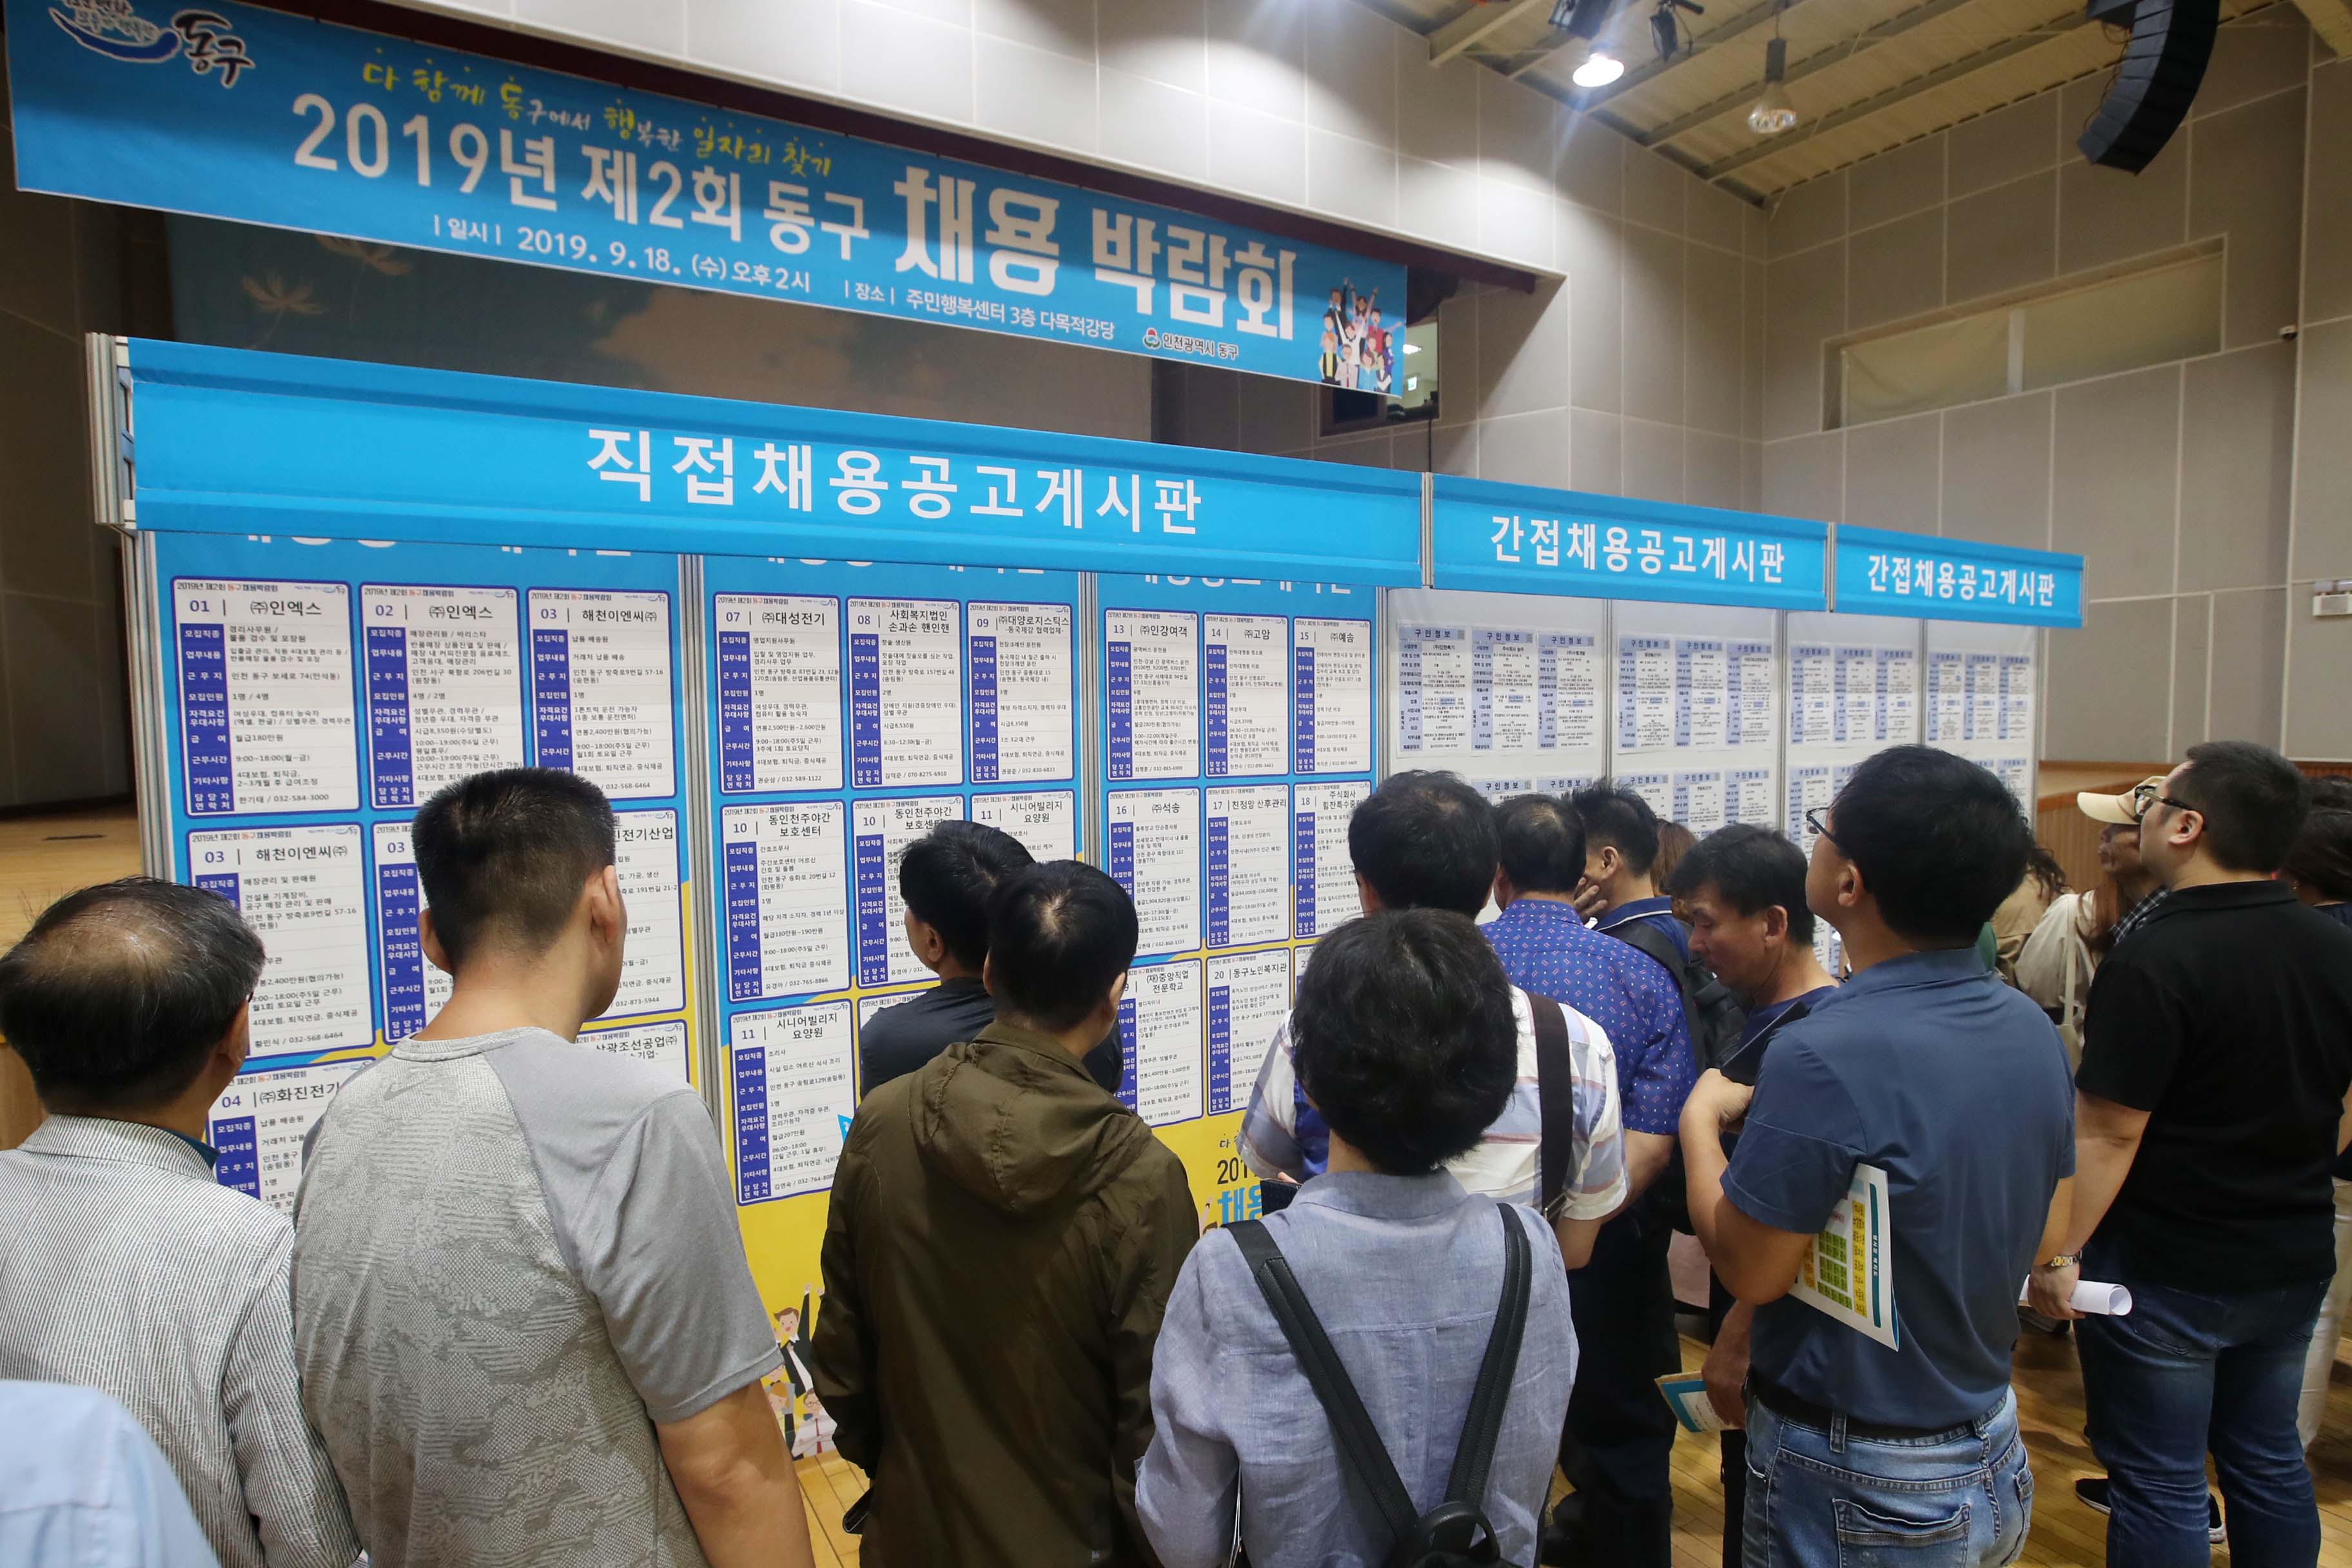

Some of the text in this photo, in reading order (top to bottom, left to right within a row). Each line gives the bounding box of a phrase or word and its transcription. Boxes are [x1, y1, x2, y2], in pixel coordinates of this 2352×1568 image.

[363, 58, 398, 92] 다
[414, 66, 485, 105] 함께
[500, 76, 591, 133] 동구에서
[694, 125, 771, 164] 일자리
[783, 141, 832, 177] 찾기
[291, 92, 1297, 340] 2019년 제2회 동구 채용 박람회
[518, 227, 598, 264] 2019.
[609, 240, 637, 269] 9.
[906, 289, 1004, 324] 주민행복센터
[1010, 307, 1036, 329] 3층
[1041, 310, 1115, 341] 다목적강당
[1162, 333, 1239, 360] 인천광역시 동구
[587, 429, 1202, 535] 직접채용공고게시판
[1490, 516, 1785, 584] 간접채용공고게시판
[1867, 554, 2055, 608] 간접채용공고게시판
[190, 600, 210, 612] 01
[376, 605, 393, 616] 02
[541, 608, 557, 620] 03
[726, 612, 741, 622] 07
[858, 610, 948, 625] 08 사회복지법인
[888, 622, 917, 632] 손과손
[977, 618, 989, 627] 09
[1113, 625, 1124, 634] 13
[1211, 629, 1220, 637] 14
[1329, 790, 1356, 799] 주식회사
[1213, 801, 1222, 810] 17
[1257, 798, 1287, 809] 산후관리
[981, 801, 1063, 820] 11 시니어빌리지
[1117, 806, 1127, 815] 16
[733, 812, 831, 834] 10 동인천주야간
[863, 807, 952, 827] 10 동인천주야간
[1024, 812, 1050, 823] 요양원
[779, 825, 821, 837] 보호센터
[387, 842, 405, 853] 03
[205, 851, 224, 863] 03
[1146, 970, 1189, 984] (재)중앙직업
[1214, 965, 1287, 979] 20 동구노인복지관
[1153, 982, 1184, 993] 전문학교
[741, 1012, 838, 1039] 11 시니어빌리지
[792, 1027, 823, 1039] 요양원
[222, 1095, 241, 1108] 04
